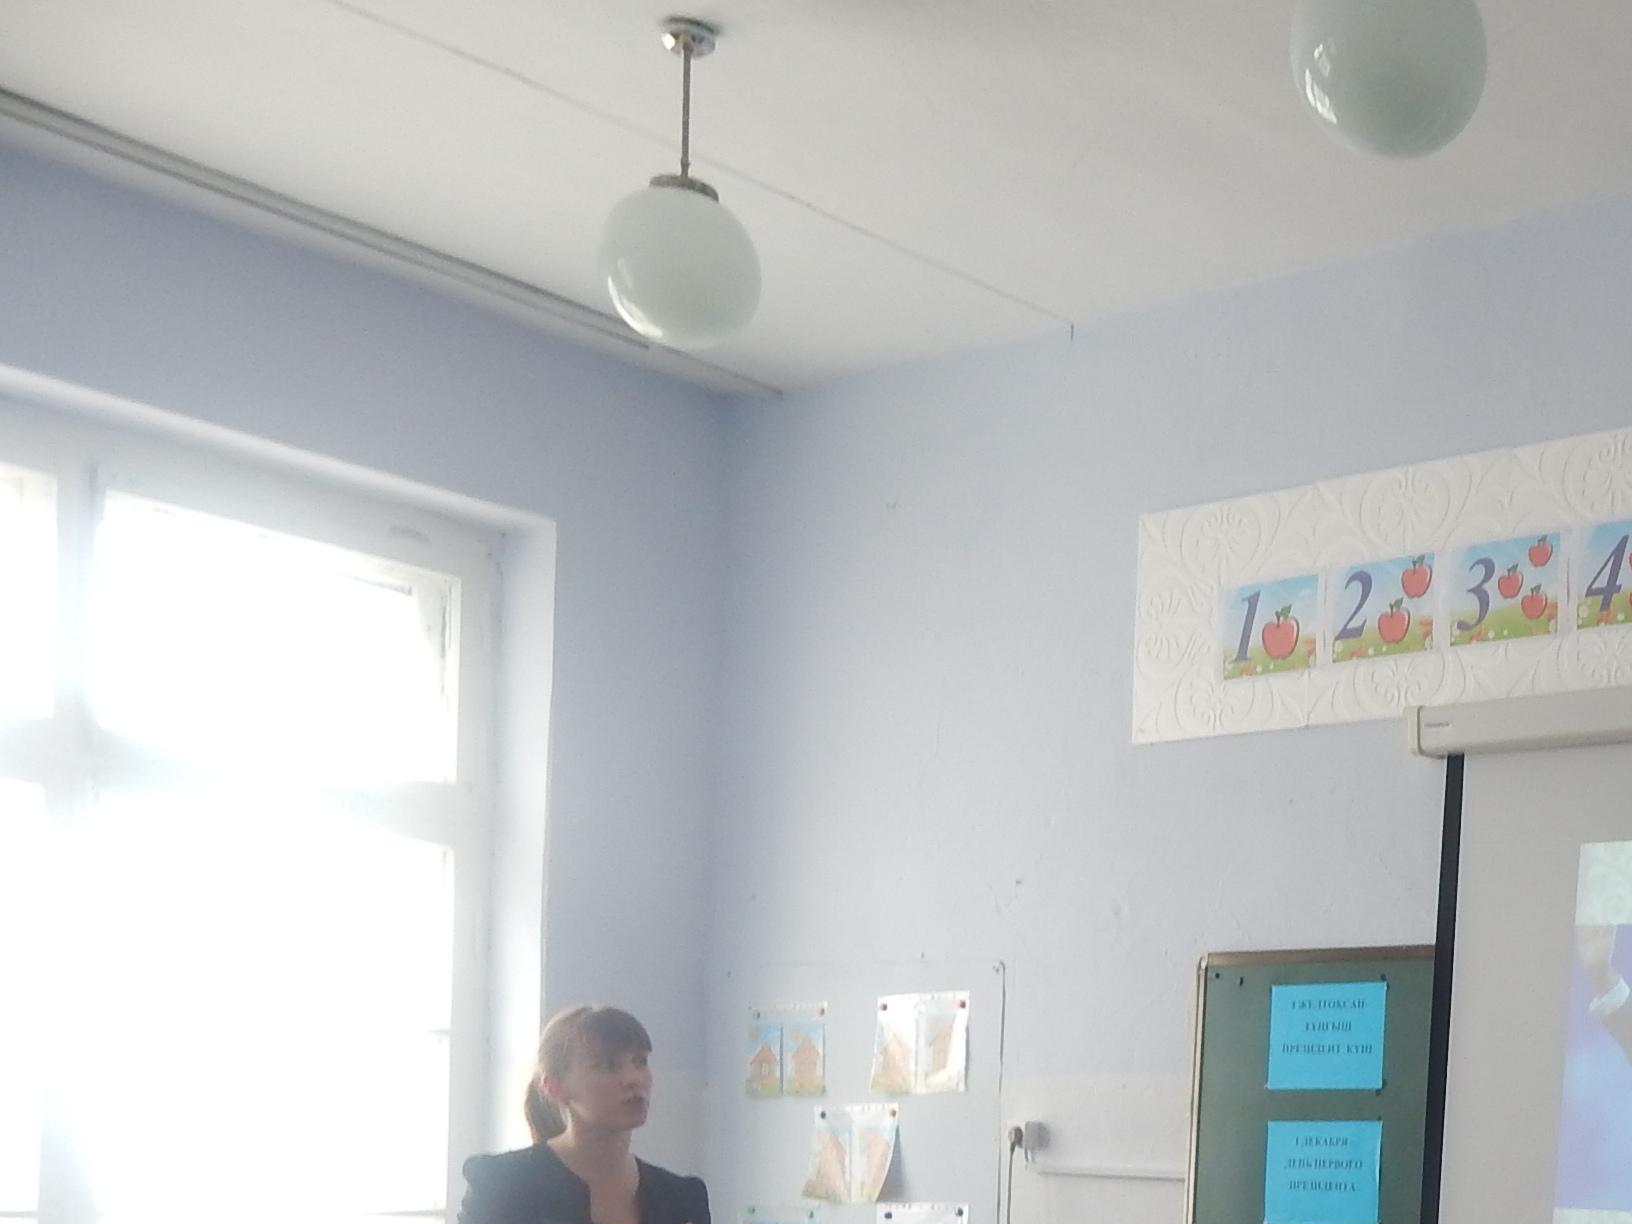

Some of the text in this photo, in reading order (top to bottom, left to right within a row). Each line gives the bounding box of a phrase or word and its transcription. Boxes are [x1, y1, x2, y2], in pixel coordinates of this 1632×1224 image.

[1234, 589, 1261, 662] 1
[1334, 569, 1373, 641] 2
[1456, 556, 1496, 632] 3
[1584, 534, 1630, 612] 4
